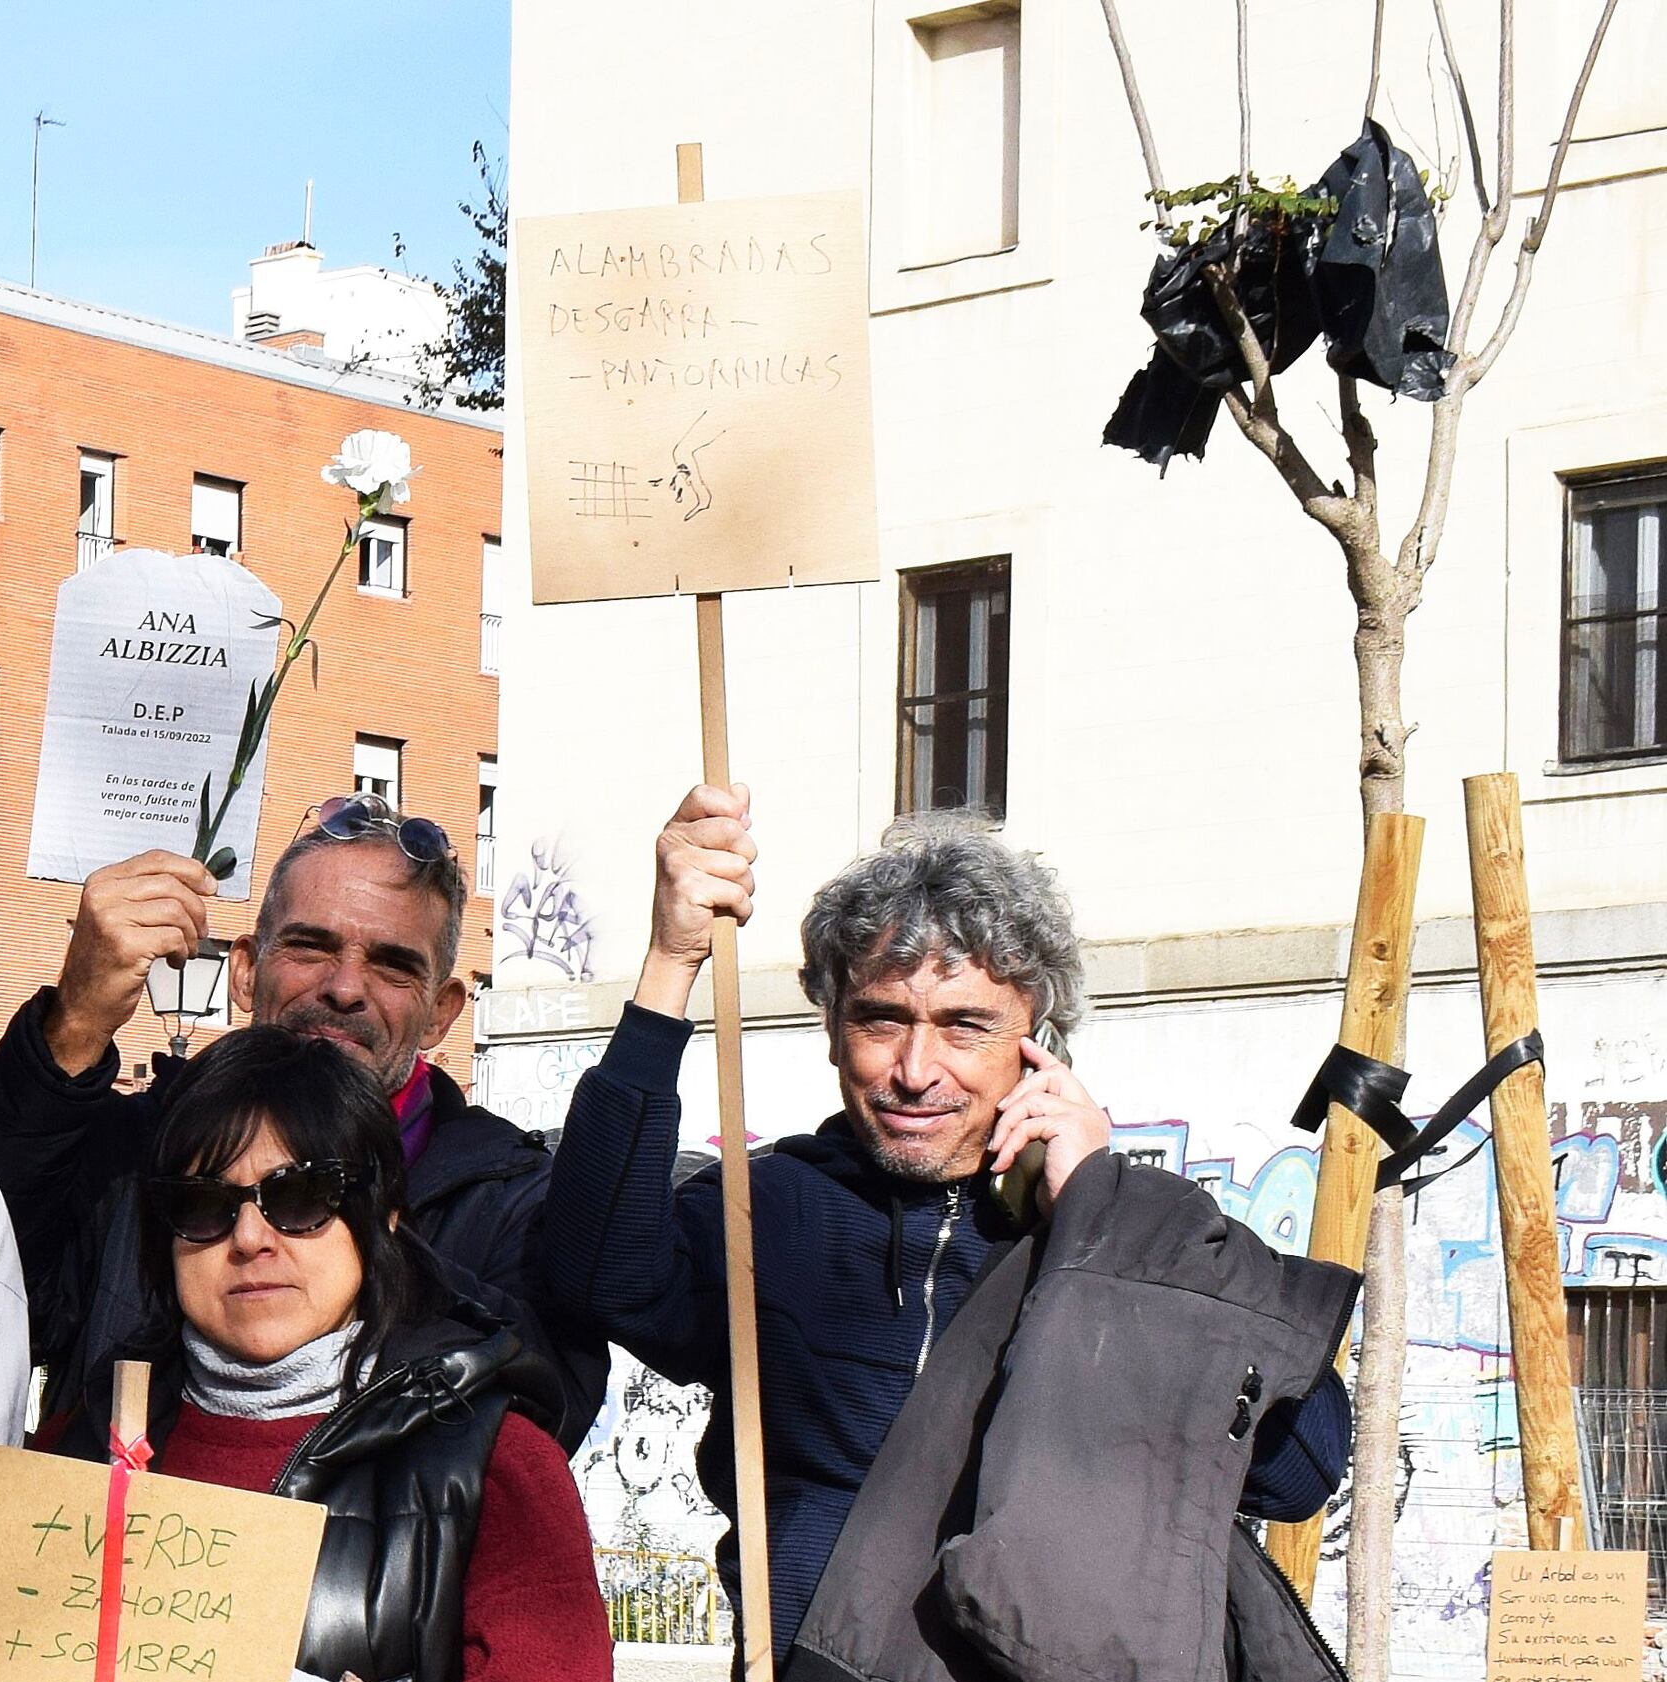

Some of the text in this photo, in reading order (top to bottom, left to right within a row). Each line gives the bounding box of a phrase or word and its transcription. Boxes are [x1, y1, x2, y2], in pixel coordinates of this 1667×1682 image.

[549, 232, 833, 278] ALAMBRADAS
[137, 609, 198, 636] ANA
[99, 636, 229, 668] ALBIZZIA
[133, 702, 185, 722] D.E.P
[102, 724, 212, 744] Talada el 15/09/2022
[105, 773, 196, 792] En las tardes de
[100, 791, 142, 805] verano,
[181, 798, 198, 808] mi
[103, 807, 190, 825] mejor consuelo
[1605, 1571, 1626, 1582] un
[61, 1574, 235, 1624] ZHORRA
[1562, 1594, 1598, 1605] como
[1499, 1613, 1536, 1625] como
[1524, 1632, 1590, 1646] existencia
